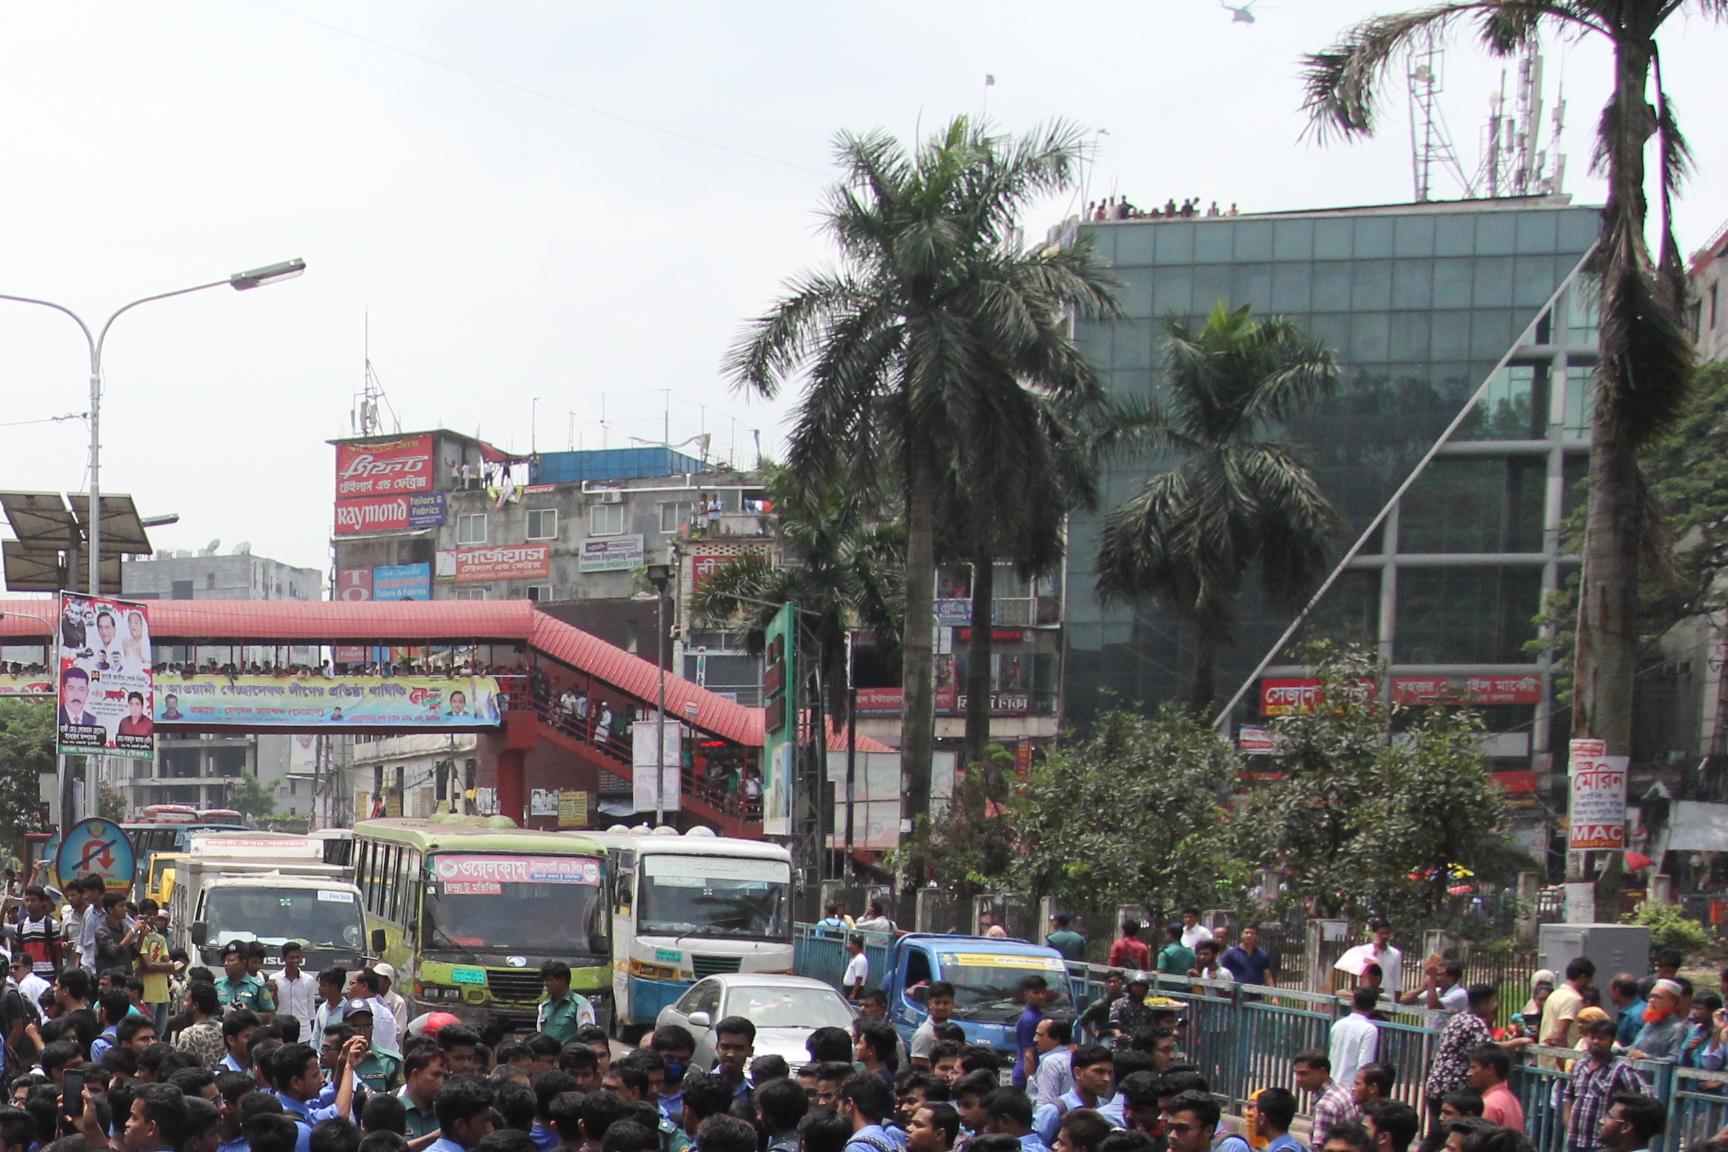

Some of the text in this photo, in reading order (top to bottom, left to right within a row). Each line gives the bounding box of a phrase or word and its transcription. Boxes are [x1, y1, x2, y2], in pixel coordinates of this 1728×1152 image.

[1573, 825, 1622, 841] MAC
[457, 860, 529, 880] ওয়েলকাম
[263, 957, 305, 965] ISUU
